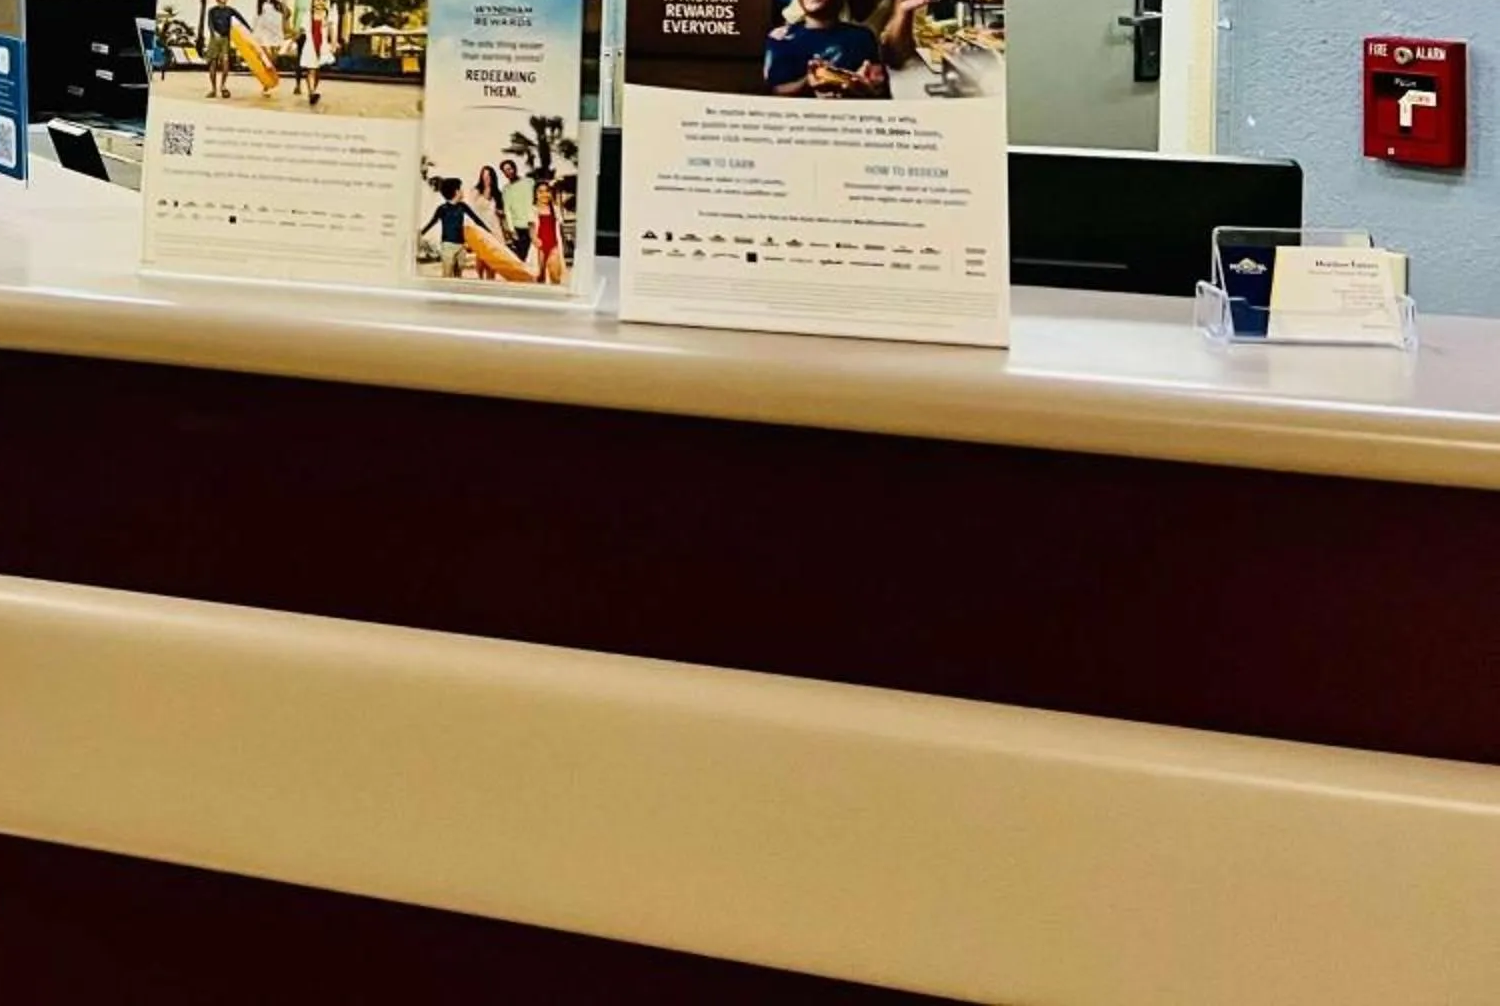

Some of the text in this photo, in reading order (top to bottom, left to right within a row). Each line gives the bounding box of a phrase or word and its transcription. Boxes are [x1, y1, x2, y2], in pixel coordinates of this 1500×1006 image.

[665, 3, 735, 20] REWARDS
[662, 19, 741, 35] EVERYONE.
[1368, 43, 1447, 61] FIRE ALARM
[465, 68, 537, 84] REDEEMING
